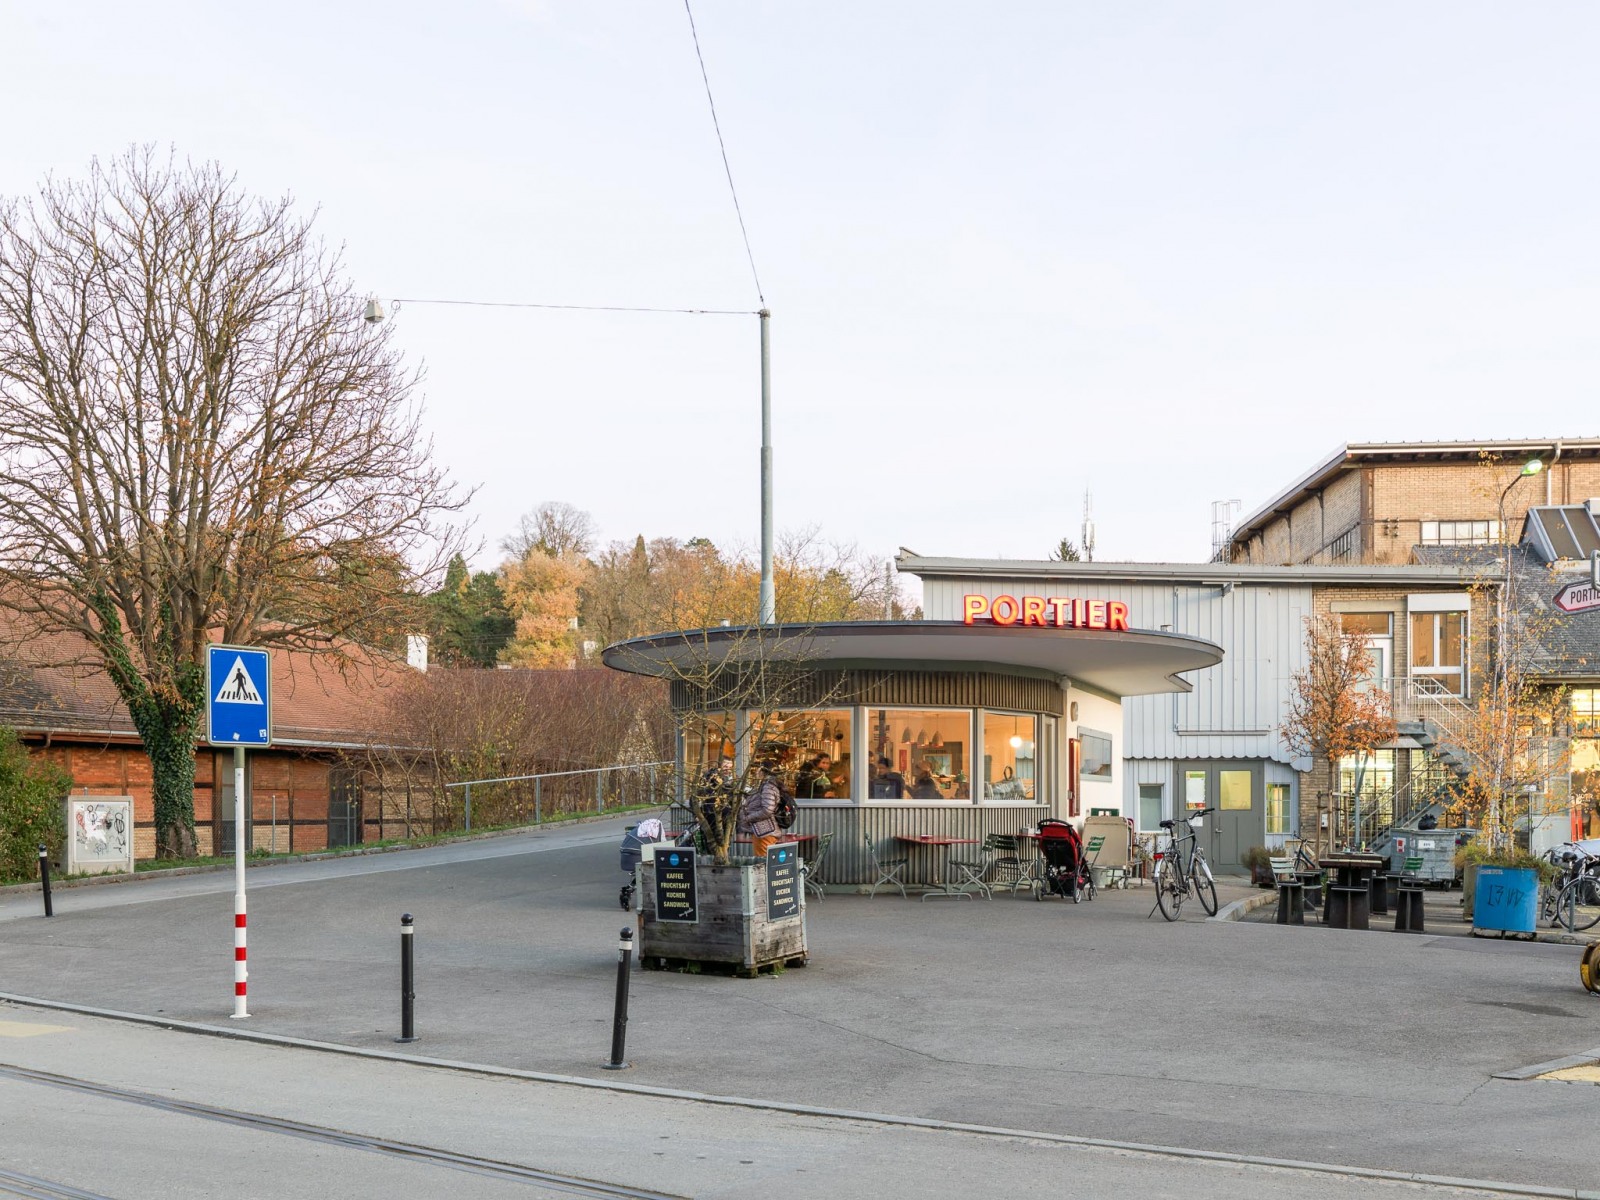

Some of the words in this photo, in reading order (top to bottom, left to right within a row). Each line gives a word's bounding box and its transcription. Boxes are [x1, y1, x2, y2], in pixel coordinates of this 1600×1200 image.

[963, 594, 1129, 631] PORTIER
[776, 868, 789, 877] KAFFEE
[771, 877, 794, 887] FRUCHTSAFT
[775, 887, 791, 896] KUCHEN
[773, 897, 794, 906] SANDWICH
